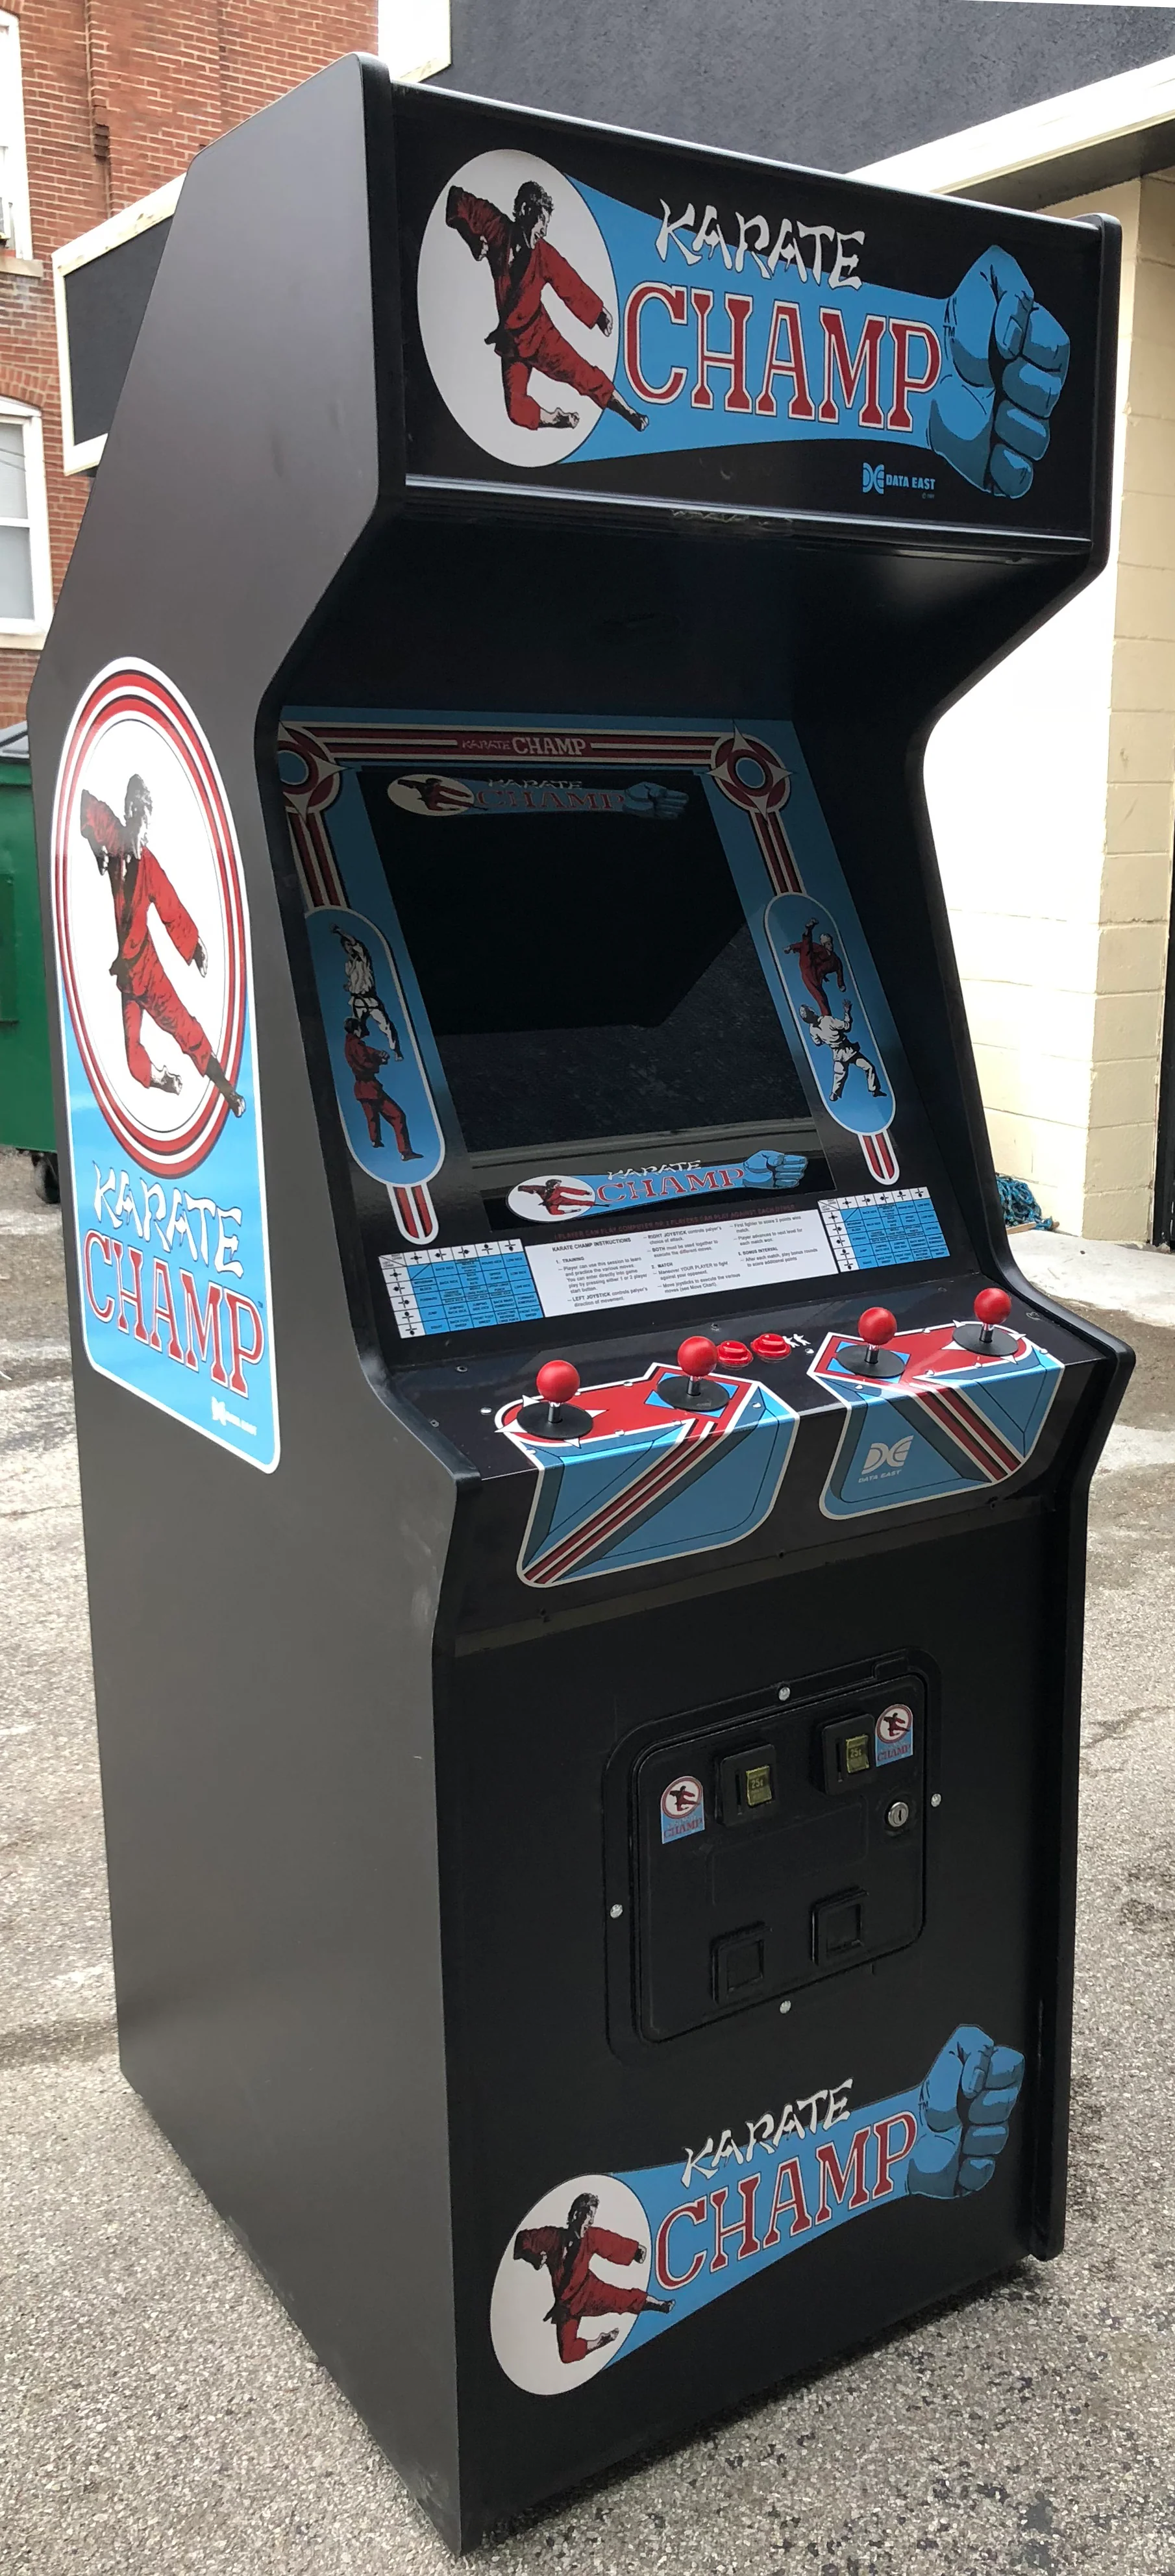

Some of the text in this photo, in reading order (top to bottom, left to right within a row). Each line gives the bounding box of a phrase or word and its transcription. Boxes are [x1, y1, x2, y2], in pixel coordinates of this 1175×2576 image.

[655, 199, 865, 290] KARATE
[624, 280, 942, 433] CHAMP
[885, 474, 936, 490] DATA EAST
[462, 737, 586, 756] KARATE CHAMP
[475, 789, 625, 811] CHAMP
[607, 1159, 701, 1181] KARATE
[595, 1167, 745, 1202] CHAMP
[92, 1160, 244, 1280] KARATE
[593, 1237, 631, 1246] INSTRUCTIONS
[84, 1228, 265, 1400] CHAMP
[858, 1469, 902, 1483] DATA EAST
[664, 1819, 703, 1839] CHAMP
[680, 2077, 854, 2188] KARATE
[655, 2111, 919, 2290] CHAMP
